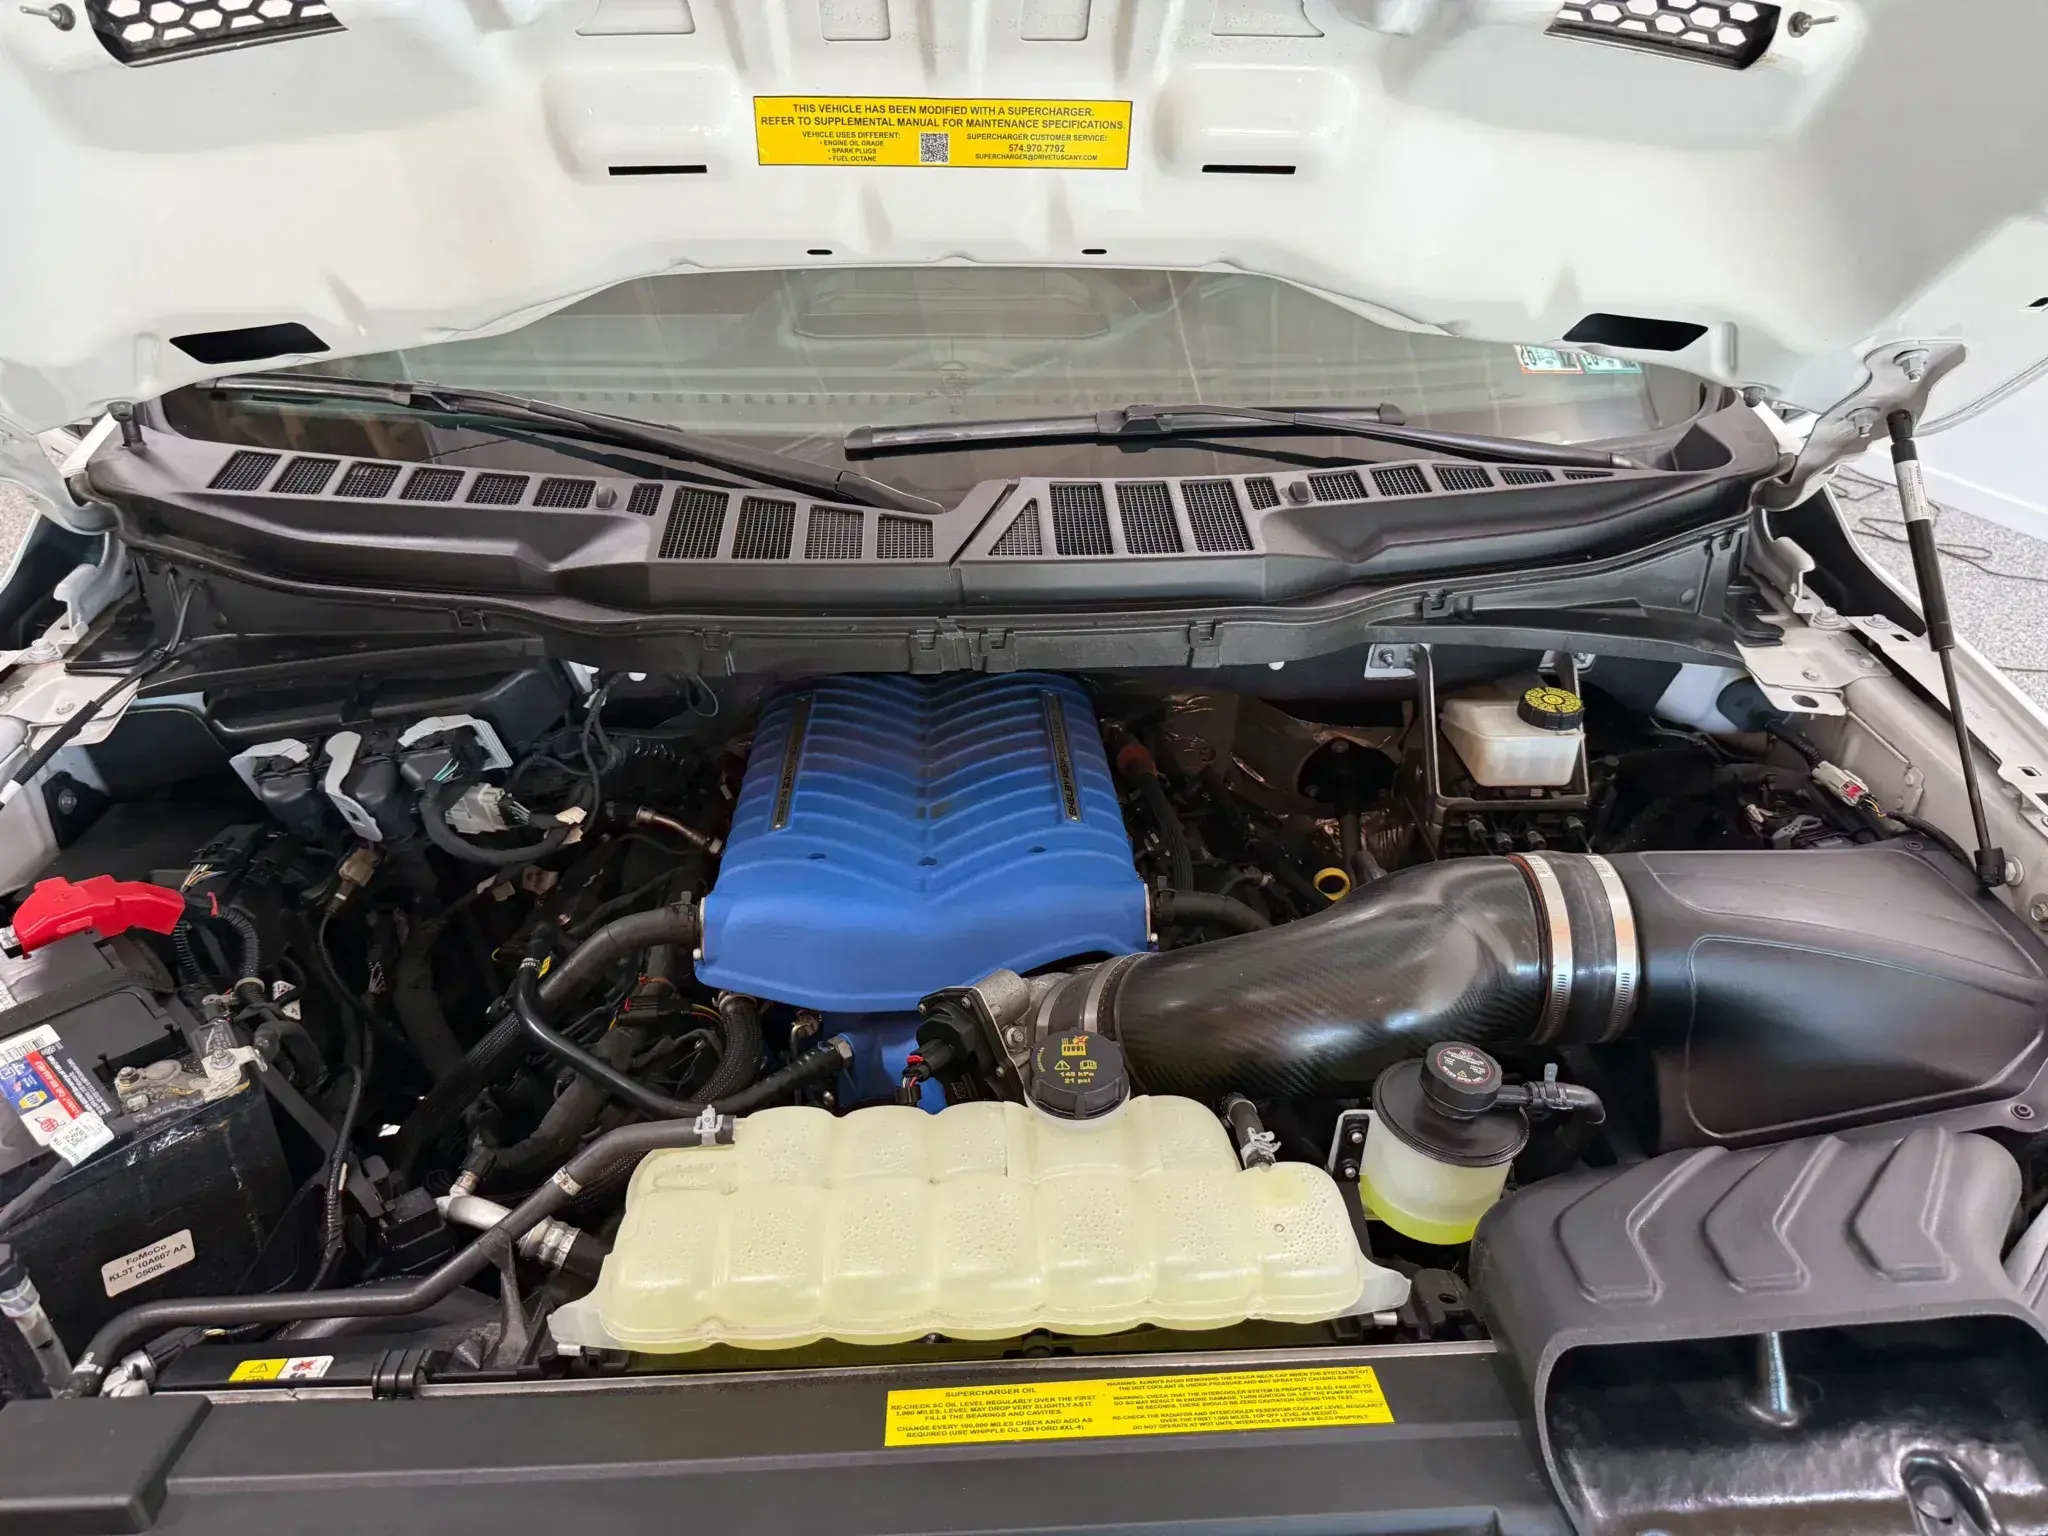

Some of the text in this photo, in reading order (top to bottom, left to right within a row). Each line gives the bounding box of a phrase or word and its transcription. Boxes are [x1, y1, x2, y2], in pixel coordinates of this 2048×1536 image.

[793, 104, 816, 112] THIS
[818, 105, 862, 113] VEHICLE
[864, 105, 886, 113] HAS
[888, 106, 916, 114] BEEN
[918, 106, 967, 114] MODIFIED
[969, 107, 996, 115] WITH
[1007, 107, 1094, 116] SUPERCHARGER.
[761, 117, 795, 125] REFER
[814, 118, 894, 126] SUPPLEMENTAL
[896, 119, 939, 127] MANUAL
[941, 119, 963, 127] FOR
[965, 119, 1039, 128] MAINTENANCE
[1040, 120, 1126, 129] SPECIFICATIONS.
[1063, 781, 1077, 816] SHELBY
[109, 1266, 134, 1282] KL3T
[173, 1244, 187, 1254] AA
[126, 1244, 167, 1266] FoMoCo
[136, 1263, 166, 1279] C500L
[945, 1389, 1020, 1397] SUPERCHARGER
